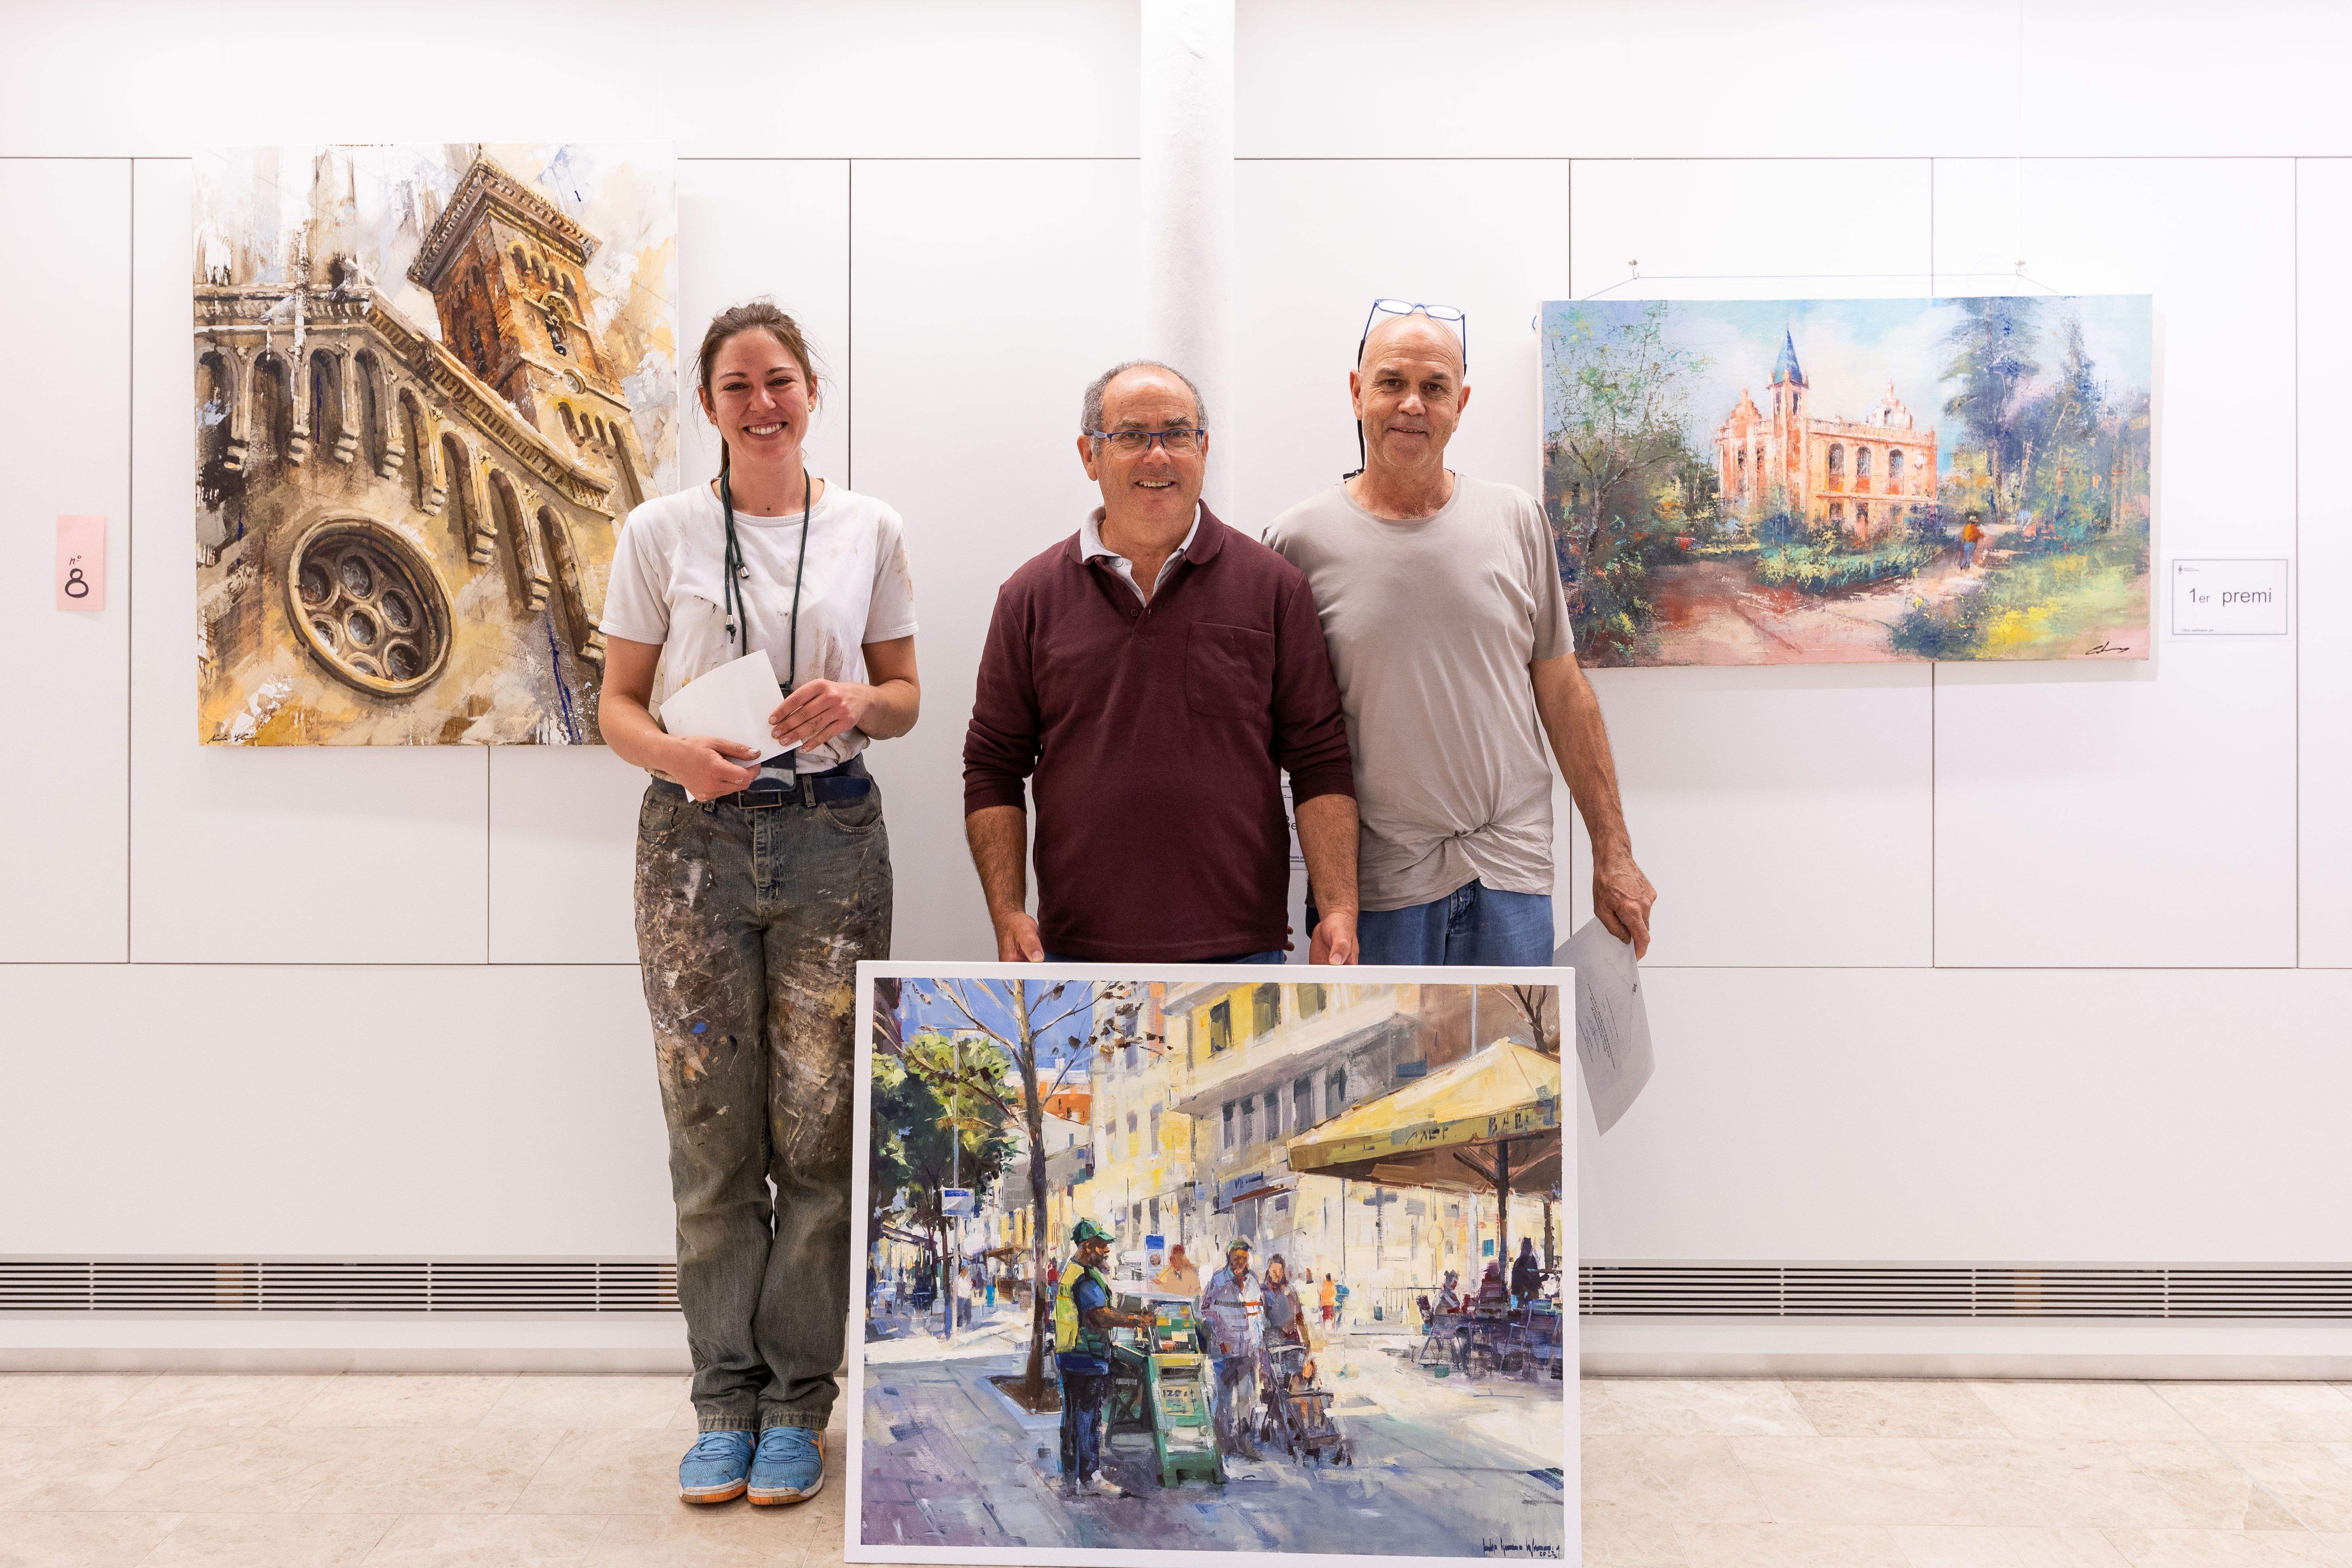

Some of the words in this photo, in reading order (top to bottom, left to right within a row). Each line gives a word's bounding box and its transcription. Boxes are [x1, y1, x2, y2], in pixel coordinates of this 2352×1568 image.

[65, 568, 89, 598] 8
[2189, 588, 2211, 603] 1er
[2222, 588, 2272, 607] premi
